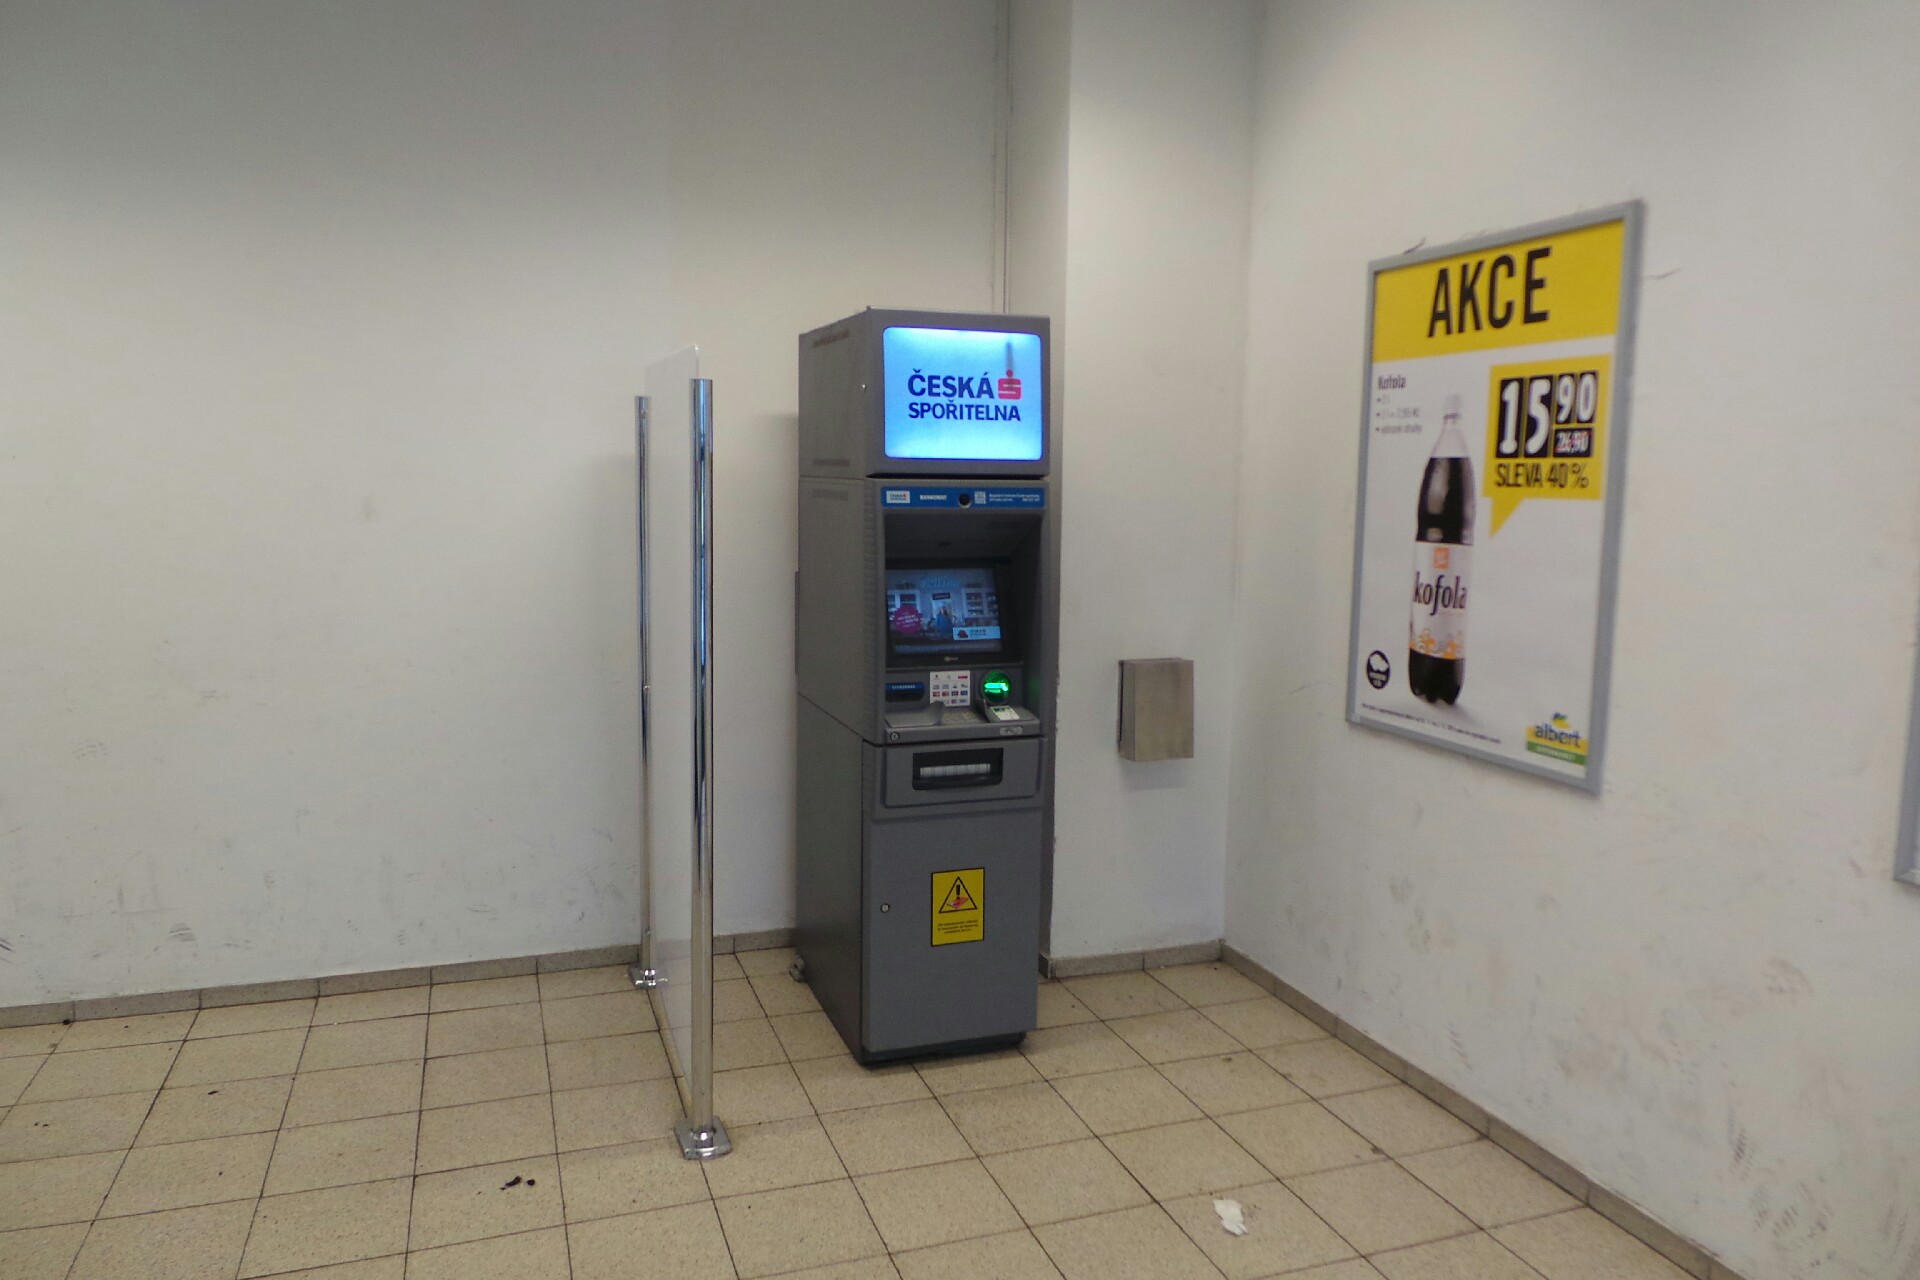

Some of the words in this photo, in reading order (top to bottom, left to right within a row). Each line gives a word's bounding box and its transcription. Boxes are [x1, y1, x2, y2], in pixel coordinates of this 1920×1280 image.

[1427, 246, 1552, 338] AKCE
[907, 369, 995, 399] ČESKÁ
[908, 400, 1021, 422] SPOŘITELNA
[1496, 462, 1543, 488] SLEVA
[1413, 571, 1467, 616] kofola
[1535, 723, 1581, 748] albert
